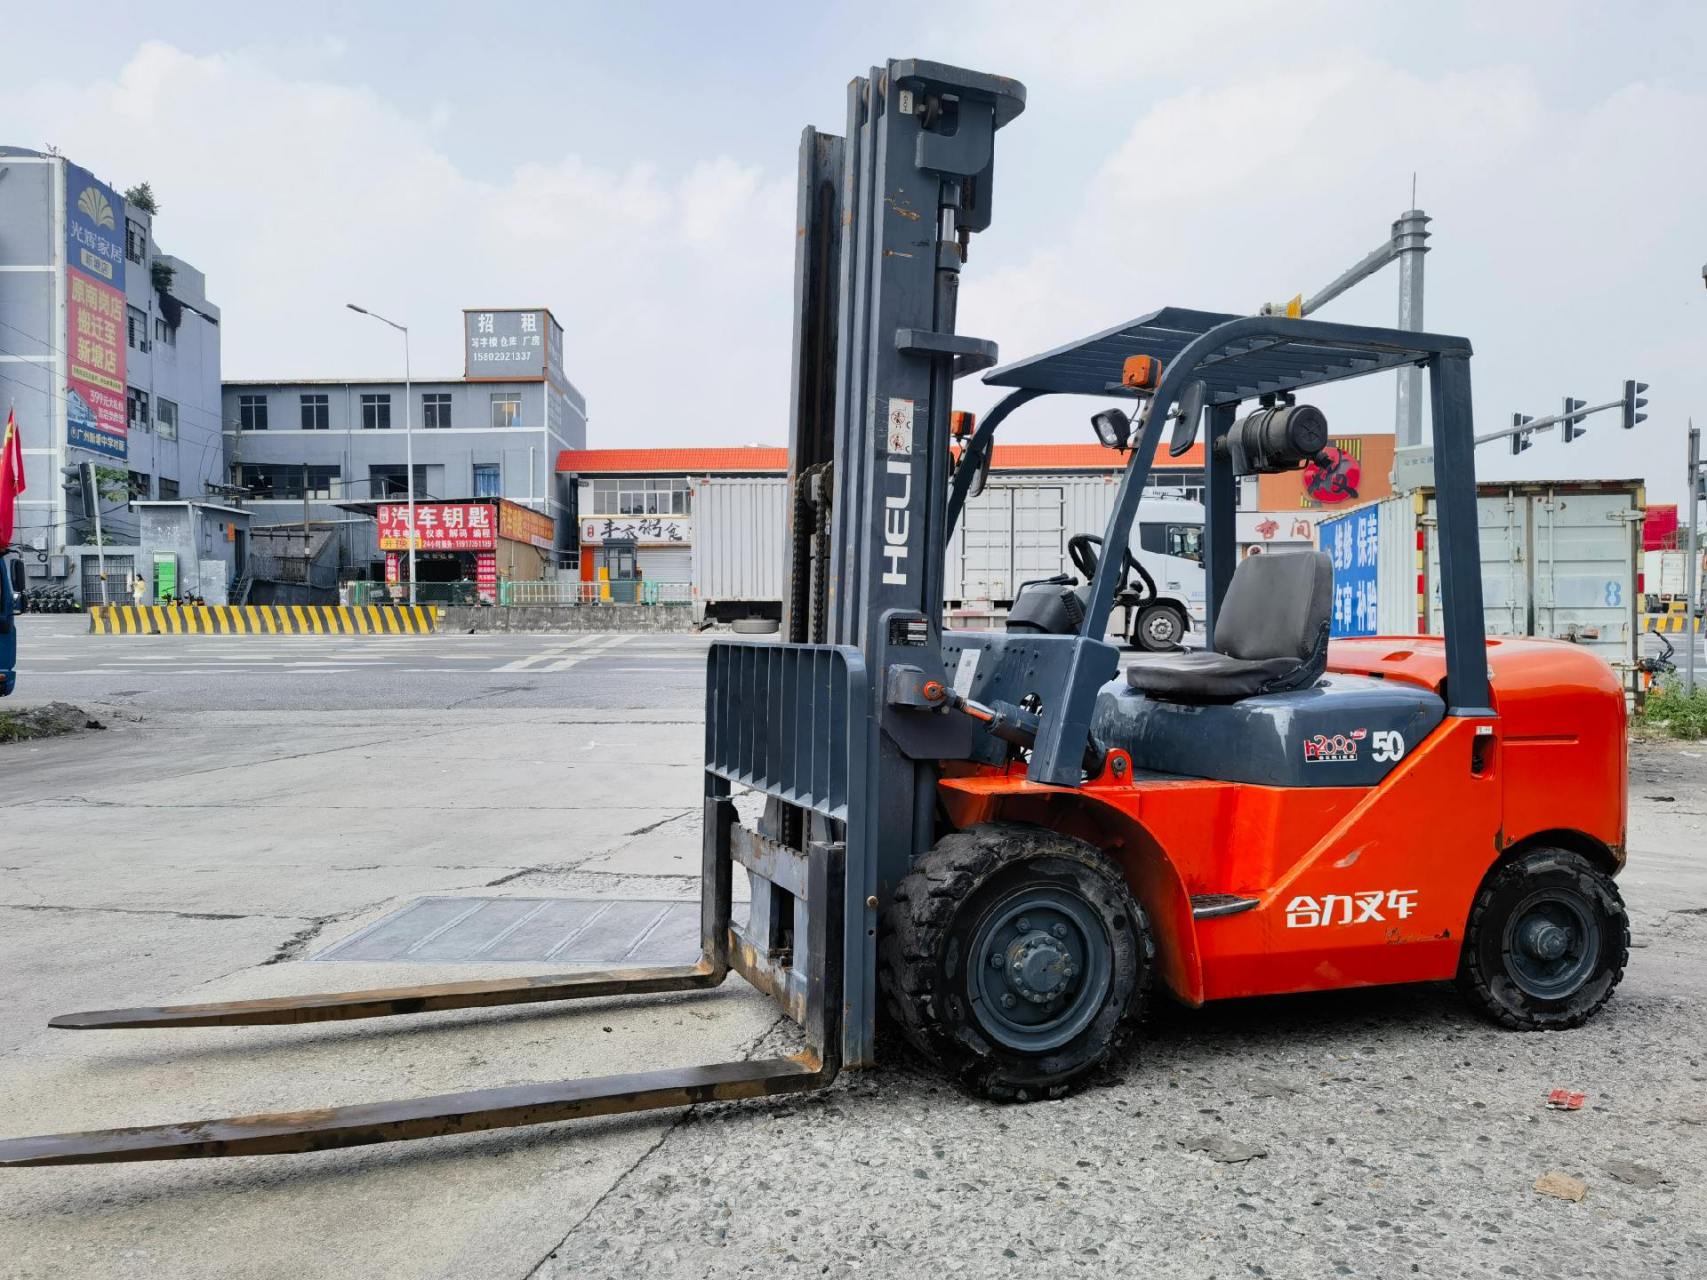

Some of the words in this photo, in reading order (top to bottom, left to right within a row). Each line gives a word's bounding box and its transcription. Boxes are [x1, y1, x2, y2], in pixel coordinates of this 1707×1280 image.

[71, 220, 122, 263] 光辉家居
[78, 337, 116, 376] 新塘店
[501, 336, 518, 348] 仓库
[522, 335, 541, 347] 厂房
[882, 461, 912, 585] HELI
[1334, 520, 1353, 571] 维修
[1357, 513, 1378, 568] 保养
[1356, 579, 1377, 632] 补胎
[1605, 580, 1622, 606] 8
[1372, 730, 1405, 763] 50
[1285, 889, 1419, 929] 合力叉车
